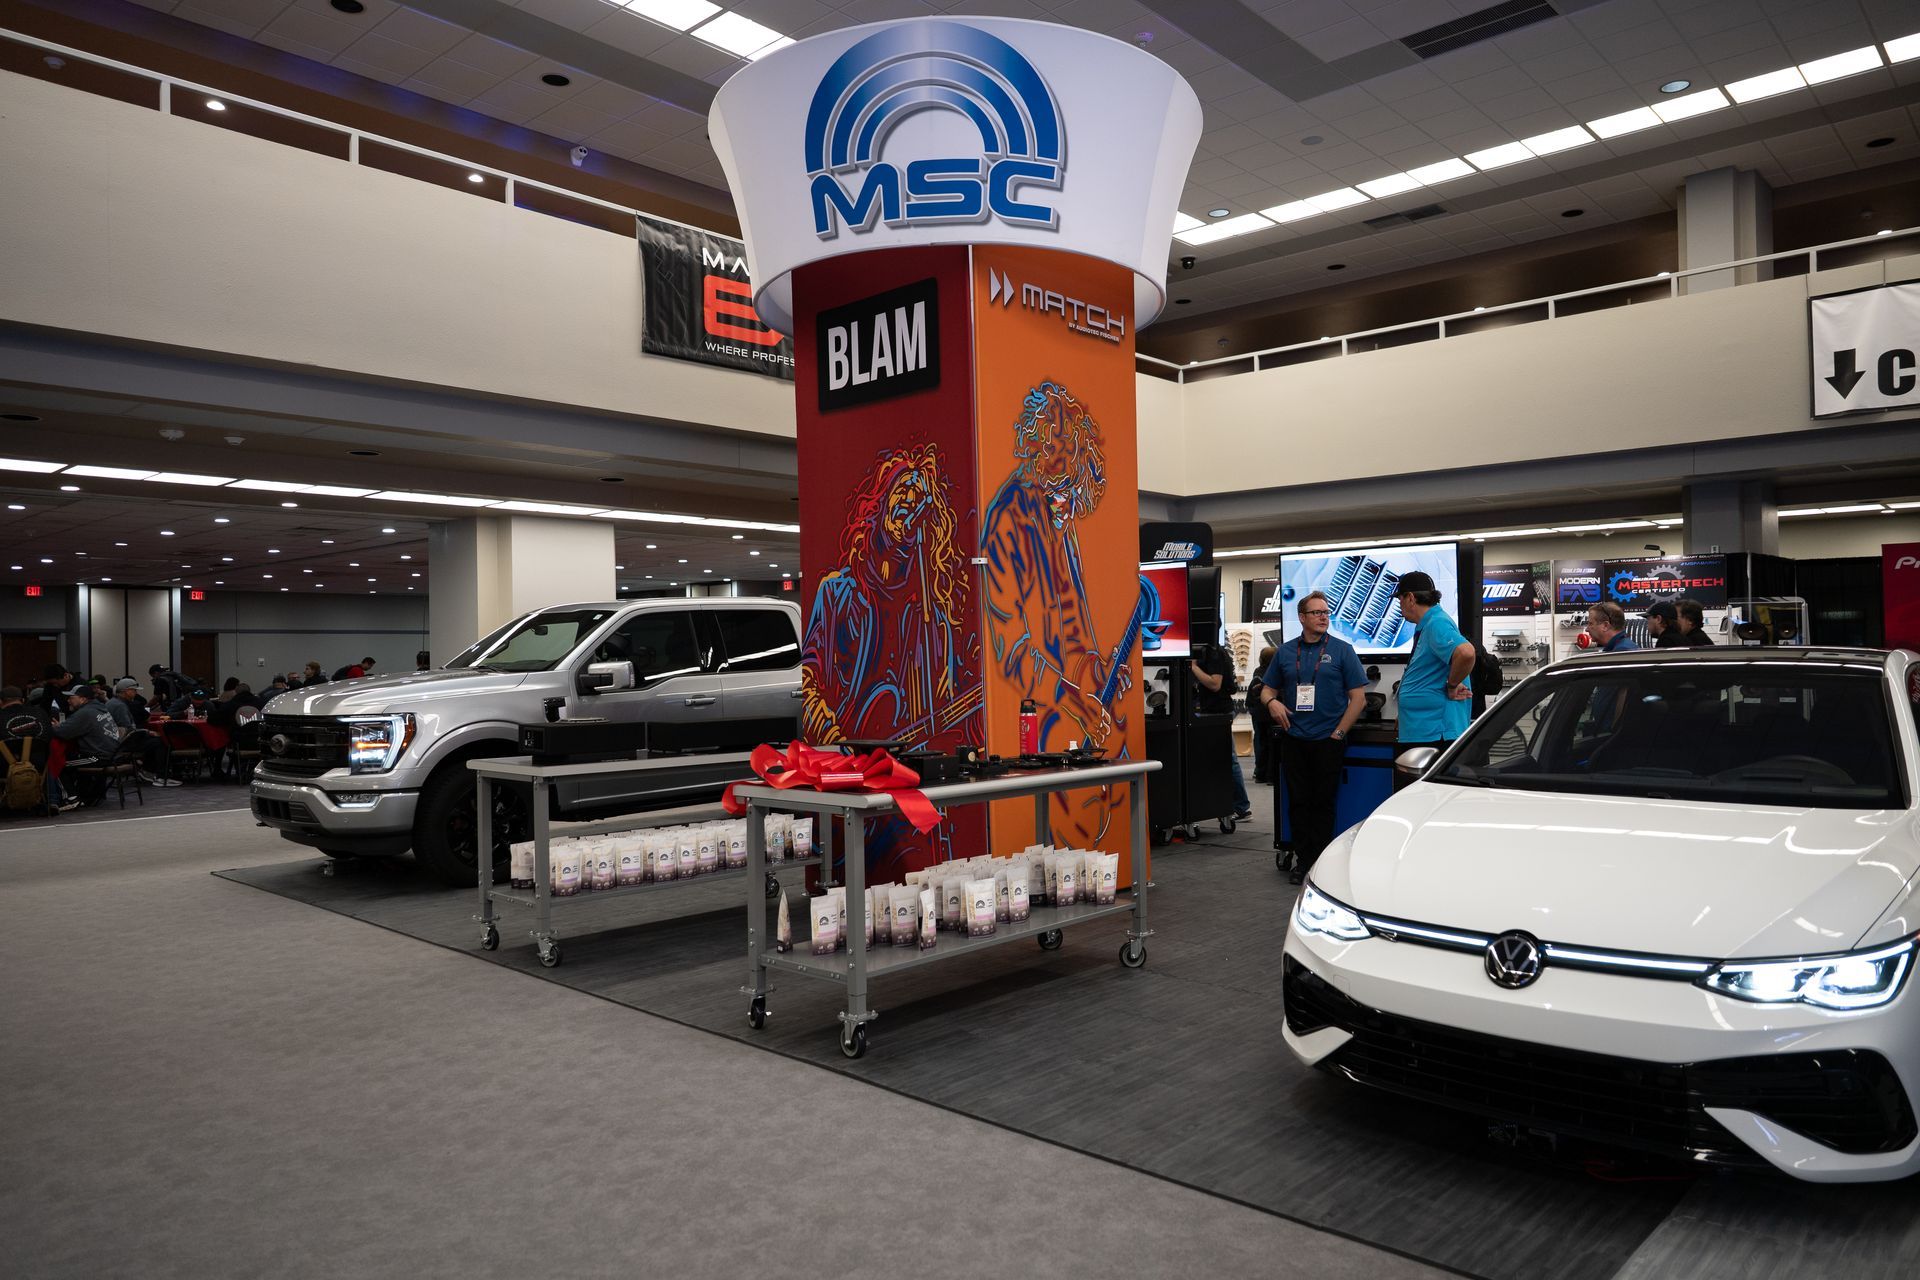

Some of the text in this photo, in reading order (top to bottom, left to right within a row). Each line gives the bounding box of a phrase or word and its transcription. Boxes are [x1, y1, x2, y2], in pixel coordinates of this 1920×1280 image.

[811, 158, 1060, 238] MSC
[1022, 283, 1125, 336] MATCH
[704, 340, 748, 358] WHERE
[827, 301, 927, 392] BLAM
[1162, 541, 1195, 551] MOBILE
[1153, 549, 1197, 560] SOLUTIONS
[1558, 577, 1601, 585] MODERN
[1618, 577, 1724, 590] MASTERTECH
[26, 586, 41, 597] EXIT
[191, 590, 204, 601] EXIT
